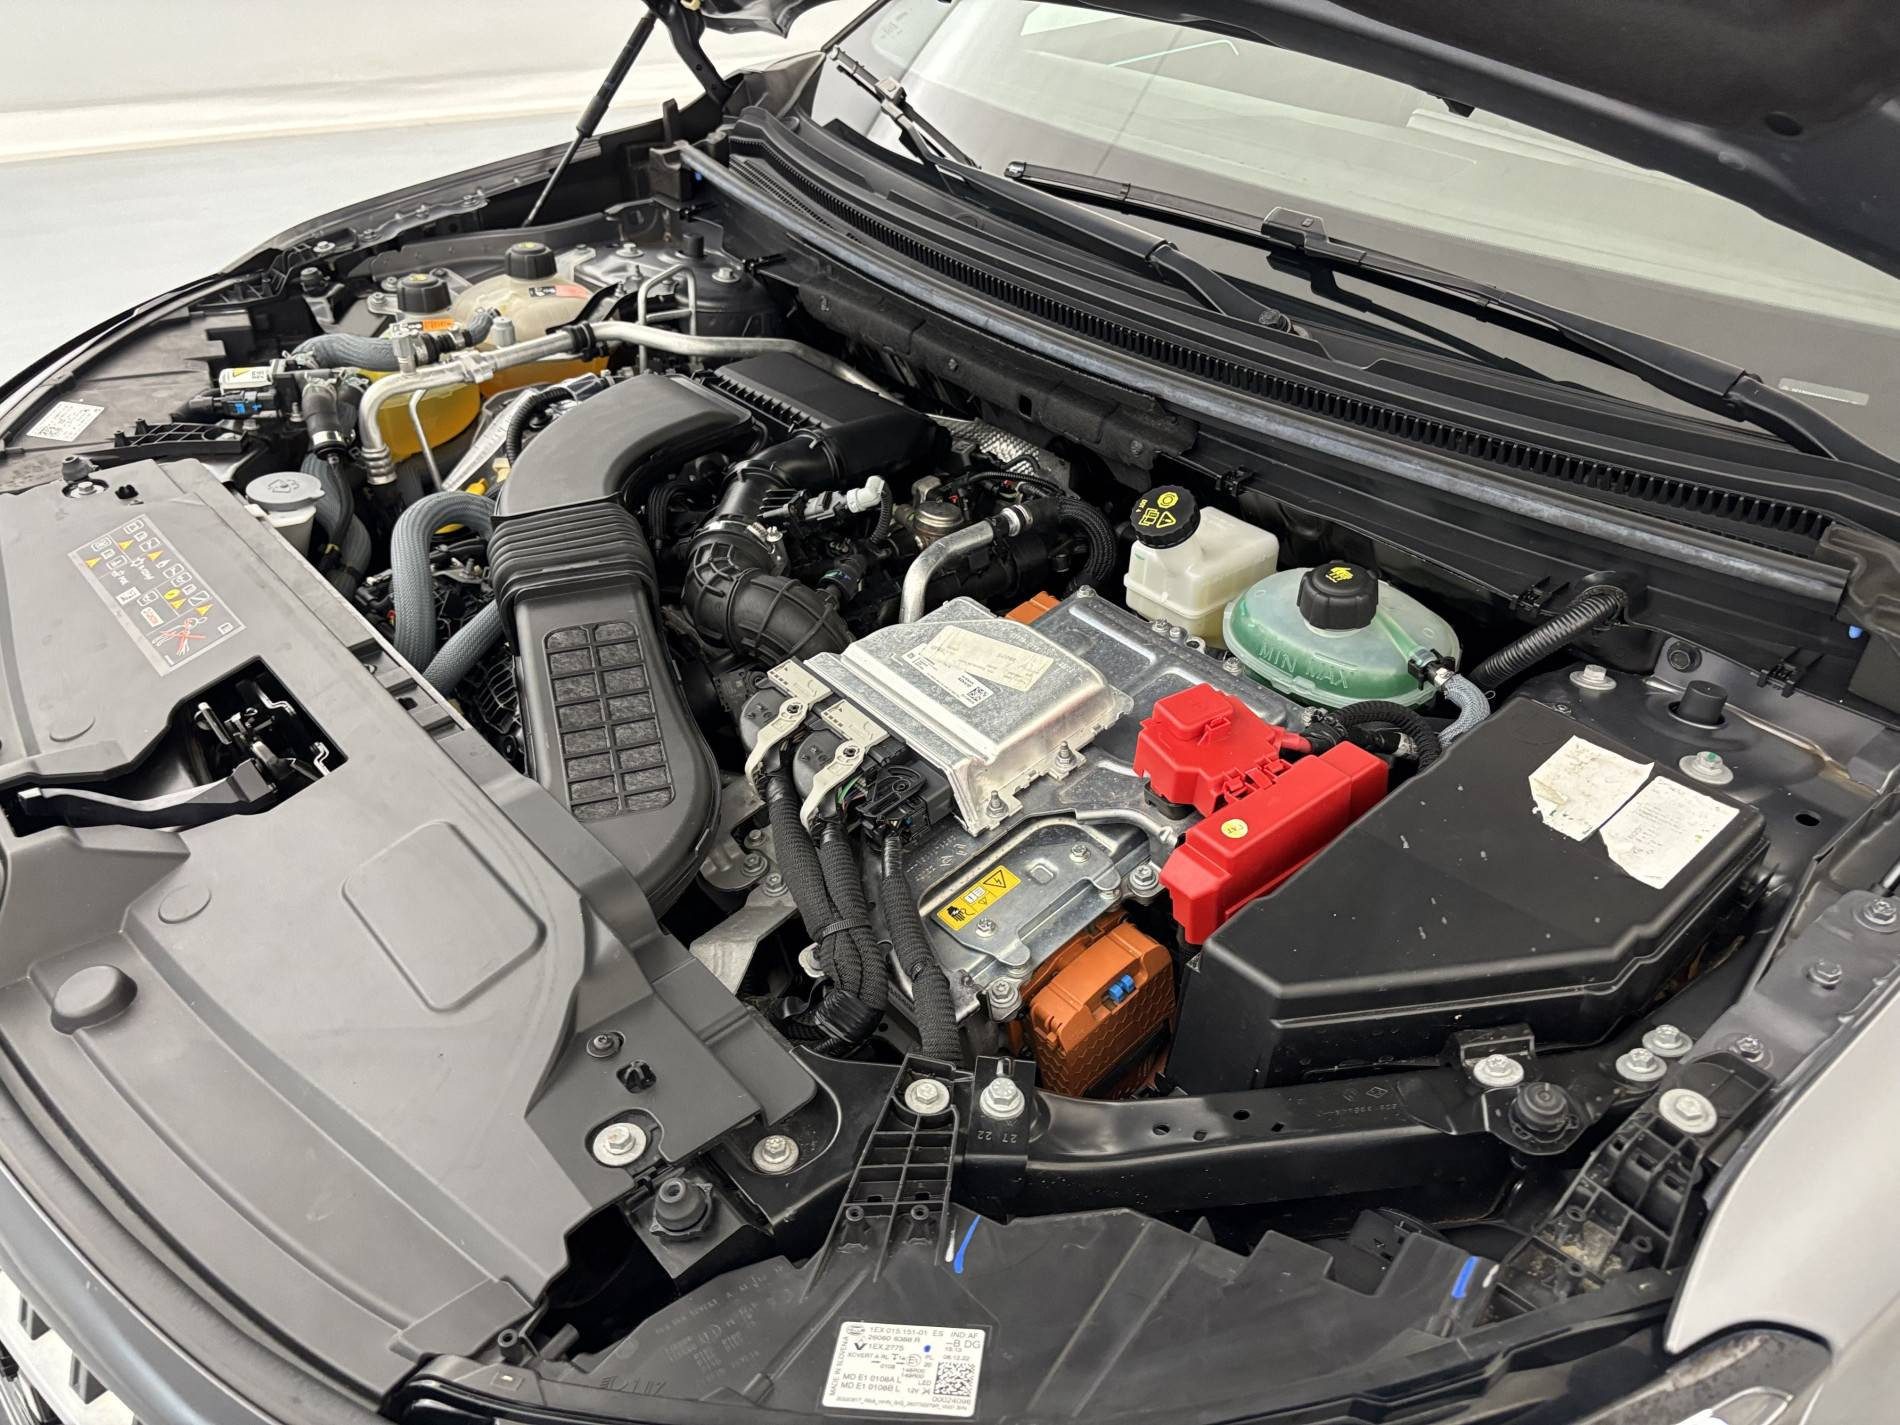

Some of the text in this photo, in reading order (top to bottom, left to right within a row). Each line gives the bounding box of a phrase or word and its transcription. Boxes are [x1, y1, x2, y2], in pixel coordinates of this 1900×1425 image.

[1259, 642, 1297, 673] MIN
[1305, 657, 1349, 689] MAX
[977, 1129, 1018, 1144] 27 22
[963, 1339, 981, 1349] DG
